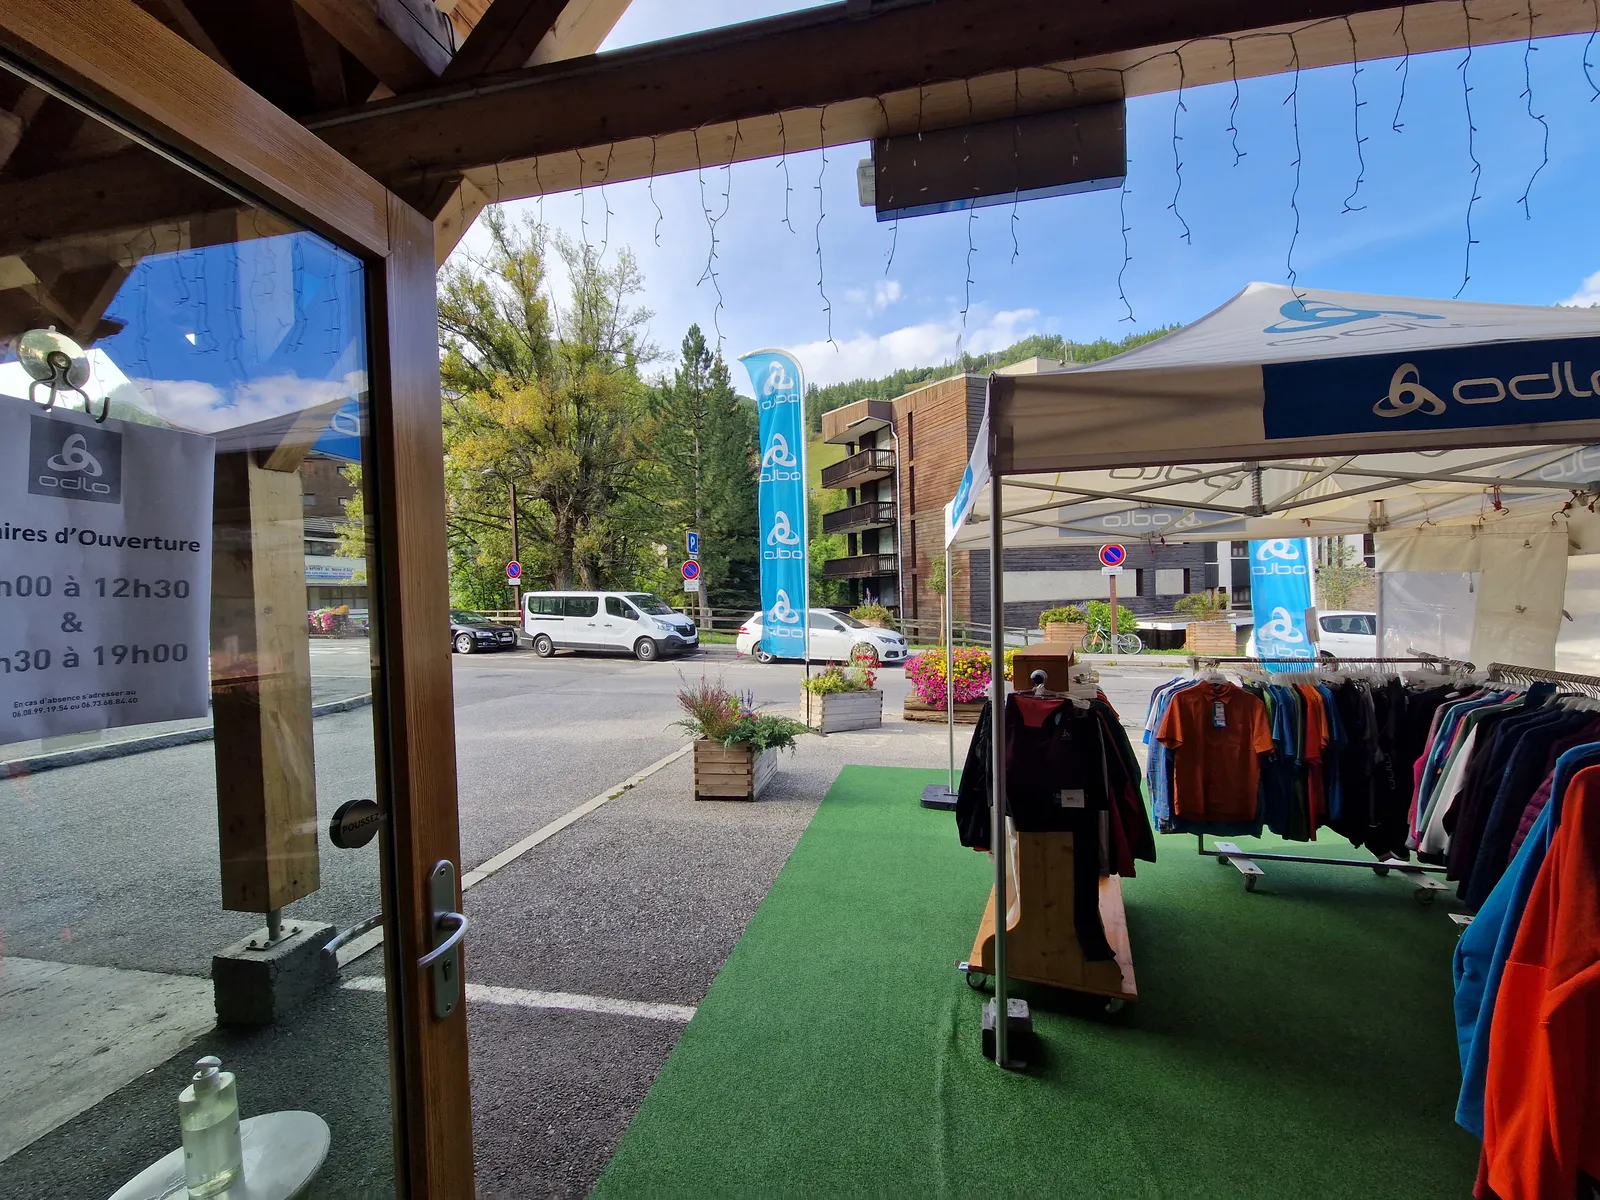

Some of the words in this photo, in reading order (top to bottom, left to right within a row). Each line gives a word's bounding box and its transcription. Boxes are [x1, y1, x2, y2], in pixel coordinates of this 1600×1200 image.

[1452, 361, 1600, 405] odl
[39, 475, 110, 494] odlo
[0, 522, 48, 543] ires
[63, 575, 81, 598] à
[95, 577, 190, 599] 12h30
[61, 611, 84, 633] &
[62, 646, 80, 668] à
[93, 643, 188, 666] 19h00
[13, 701, 23, 709] En
[25, 699, 38, 707] cas
[342, 812, 380, 834] POUSSEZ
